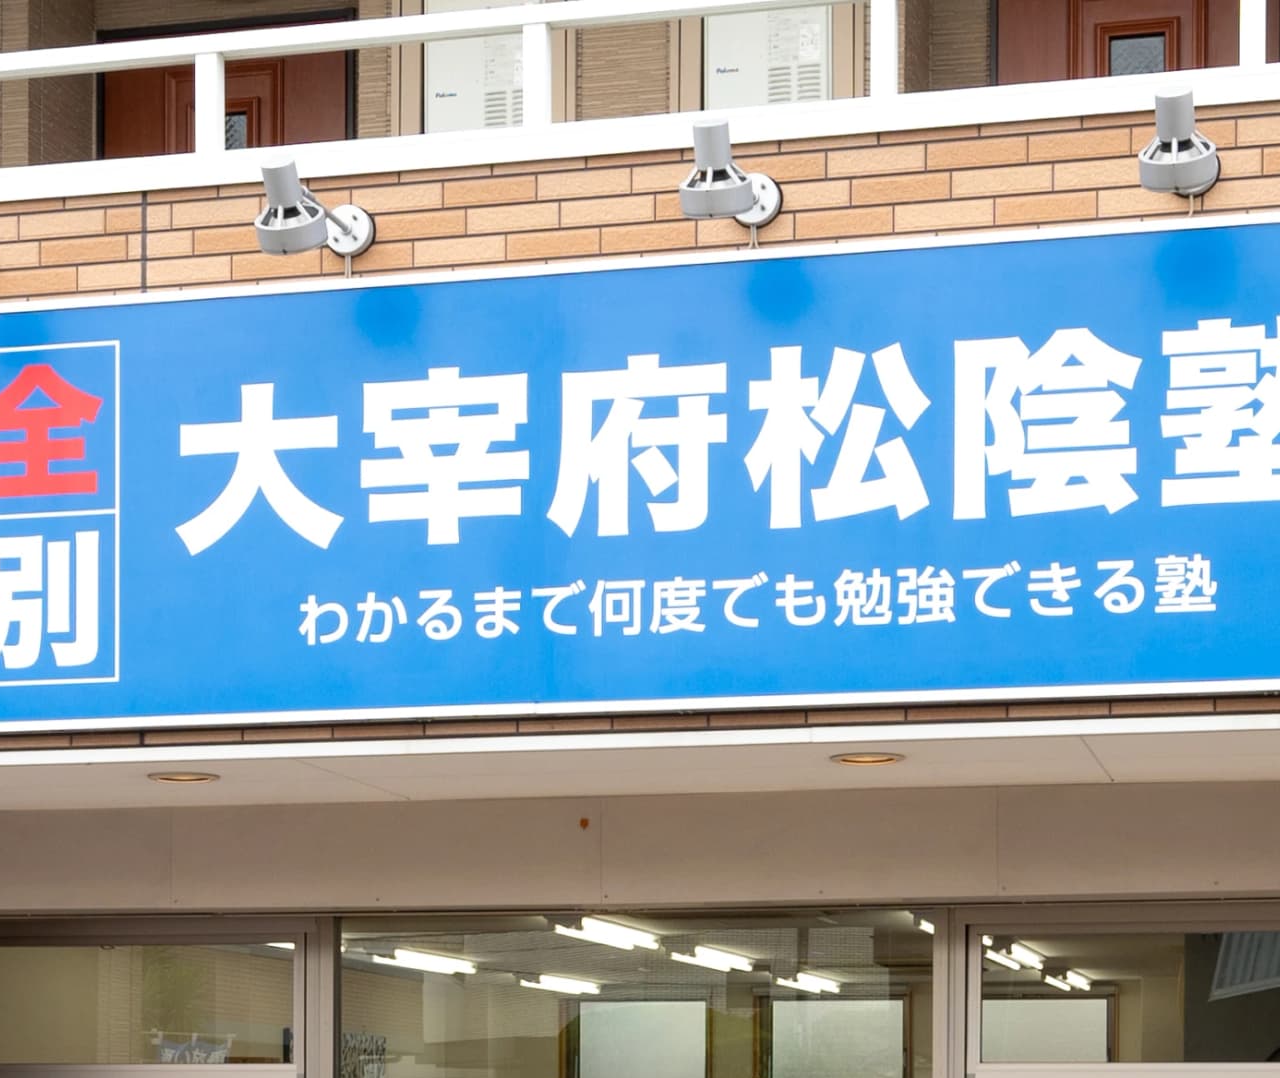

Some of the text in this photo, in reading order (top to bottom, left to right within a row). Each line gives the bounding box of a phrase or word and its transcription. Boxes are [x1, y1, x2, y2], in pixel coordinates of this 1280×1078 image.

[297, 553, 1219, 646] わかるまで何度でも勉強できる塾
